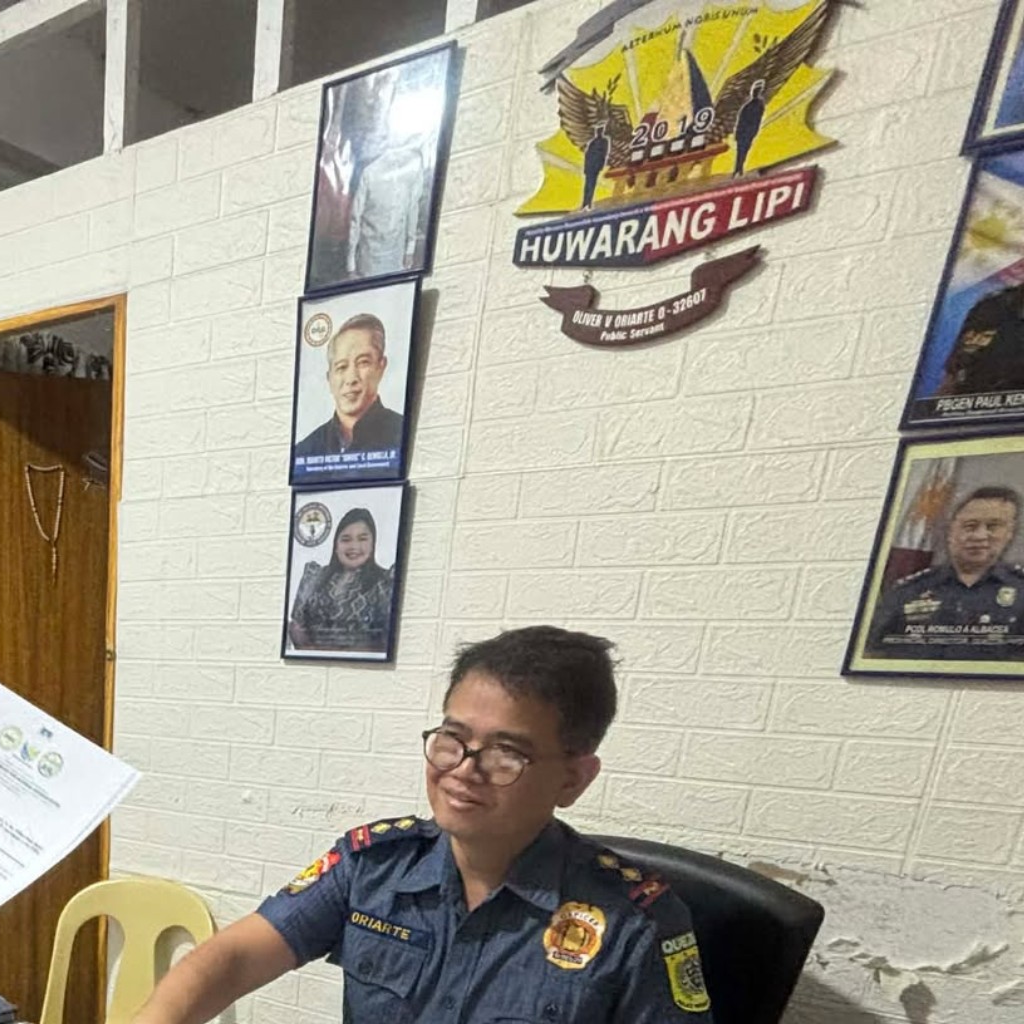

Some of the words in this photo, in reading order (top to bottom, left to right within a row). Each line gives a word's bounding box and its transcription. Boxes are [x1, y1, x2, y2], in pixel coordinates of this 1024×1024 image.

[630, 107, 715, 149] 2019
[519, 201, 717, 262] HUWARANG
[728, 182, 804, 230] LIPI
[572, 310, 601, 326] OLIVER
[604, 314, 612, 328] V
[614, 308, 655, 329] ORIARTE
[600, 330, 627, 341] Public
[629, 322, 665, 339] Servant
[351, 912, 411, 940] ORIARTE
